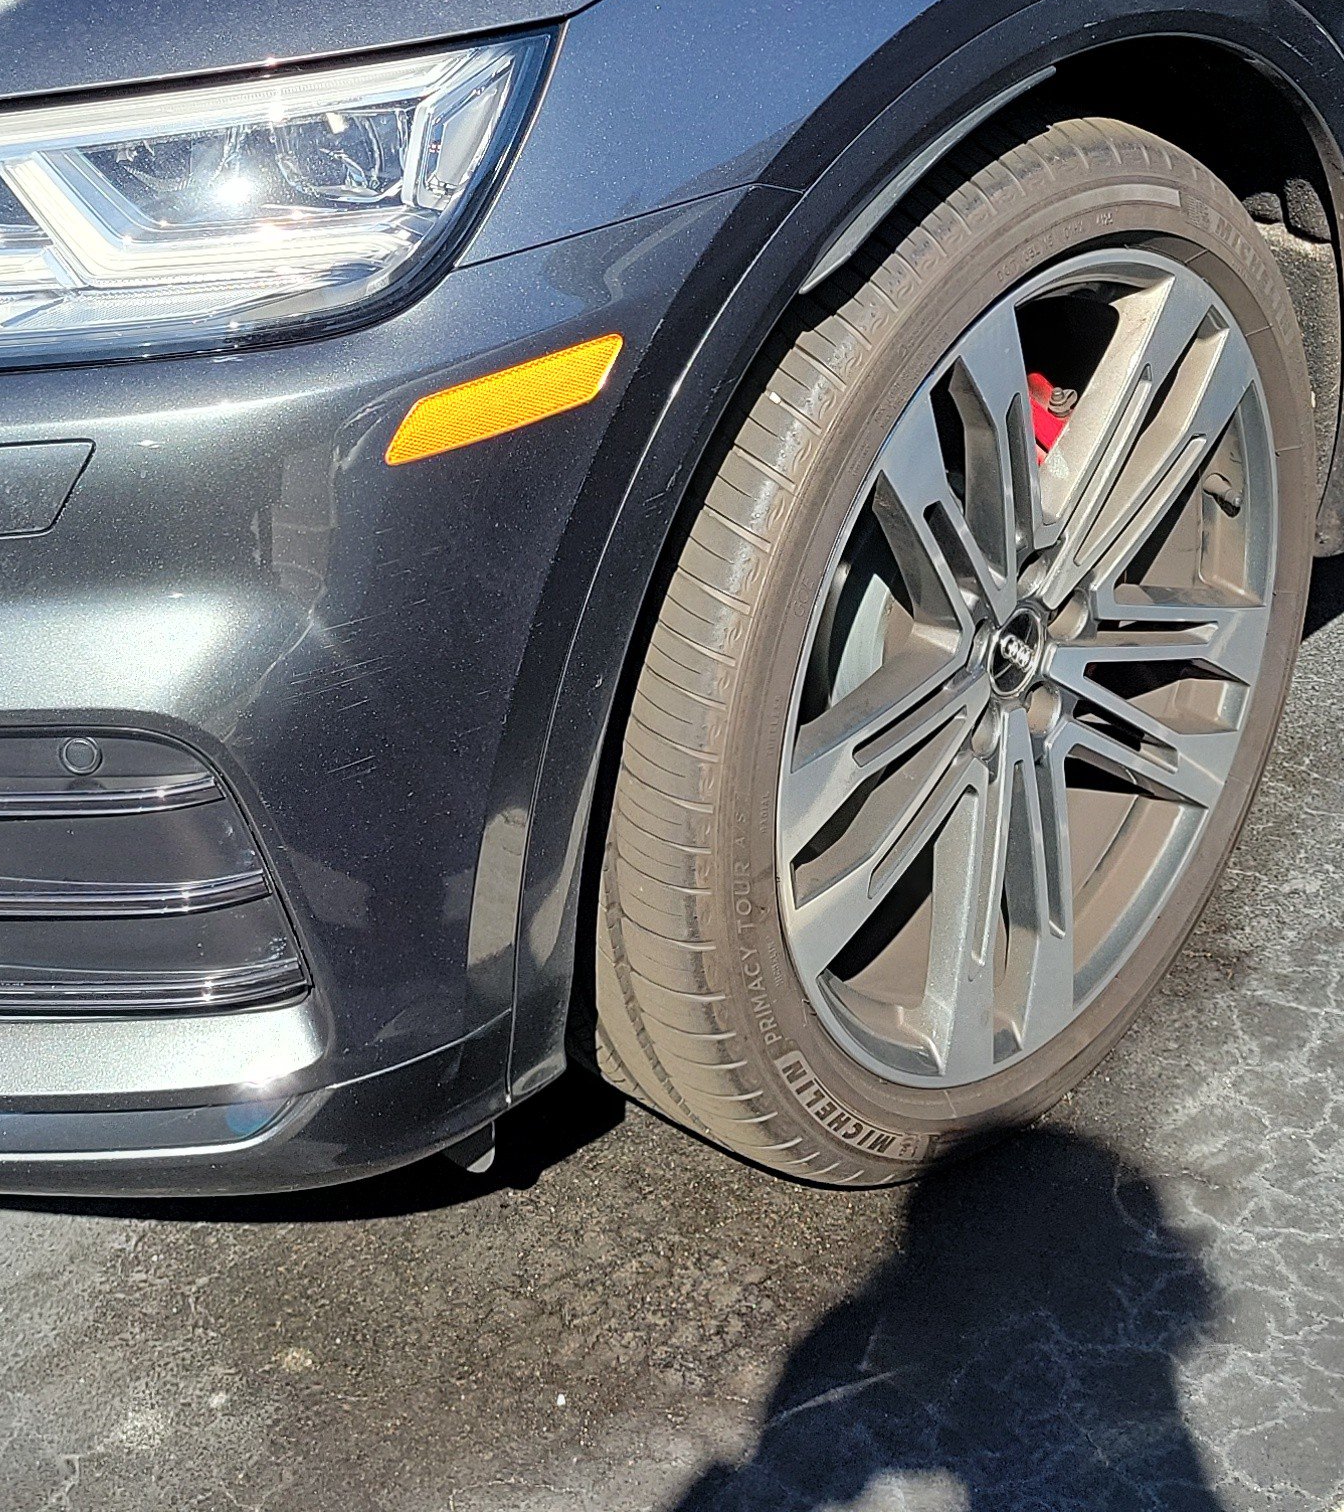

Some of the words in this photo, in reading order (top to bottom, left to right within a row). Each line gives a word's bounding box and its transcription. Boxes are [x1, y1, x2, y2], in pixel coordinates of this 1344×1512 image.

[734, 861, 755, 934] TOUR
[739, 946, 783, 1046] PRIMACY
[782, 1059, 896, 1154] MICHELIN
